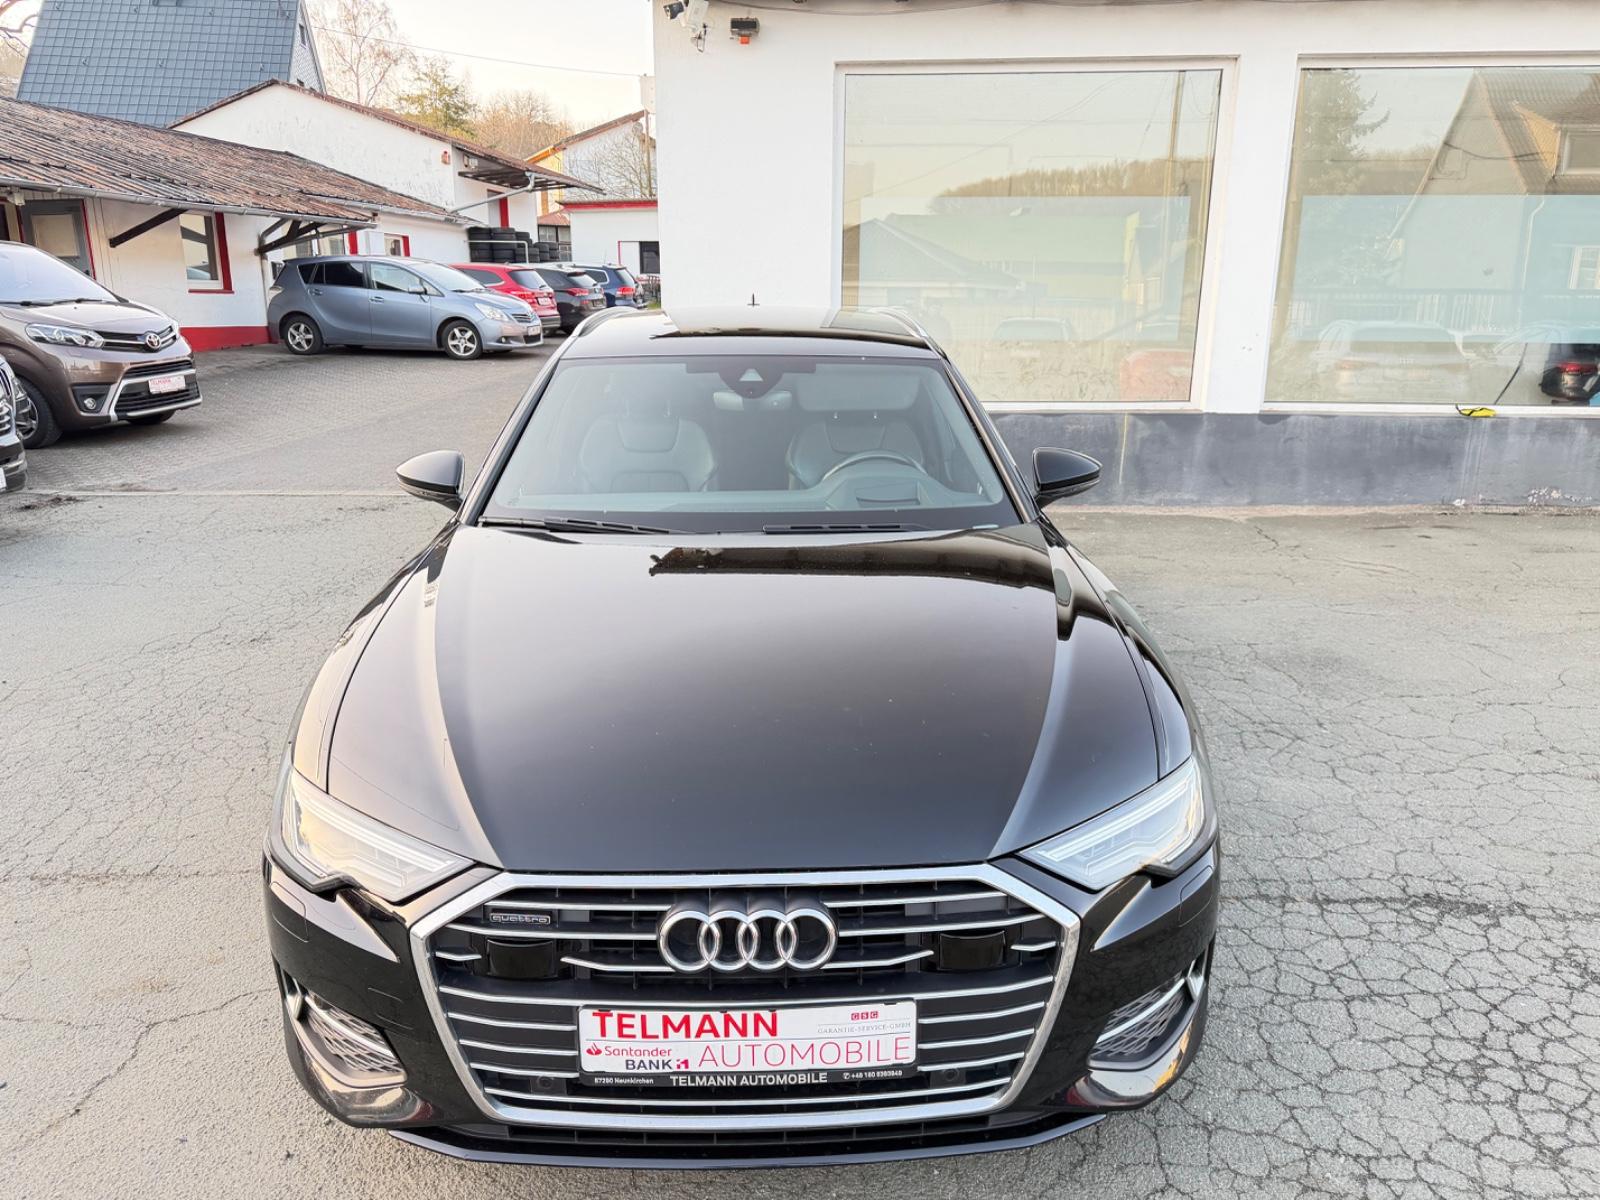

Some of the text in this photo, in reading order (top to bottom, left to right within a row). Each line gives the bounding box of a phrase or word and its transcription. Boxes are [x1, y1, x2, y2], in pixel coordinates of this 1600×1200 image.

[492, 915, 548, 923] quattro
[592, 1010, 777, 1039] TELMANN
[604, 1045, 672, 1057] Santander
[698, 1037, 911, 1068] AUTOMOBILE
[625, 1059, 673, 1071] BANK
[670, 1072, 828, 1087] TELMANN AUTOMOBILE
